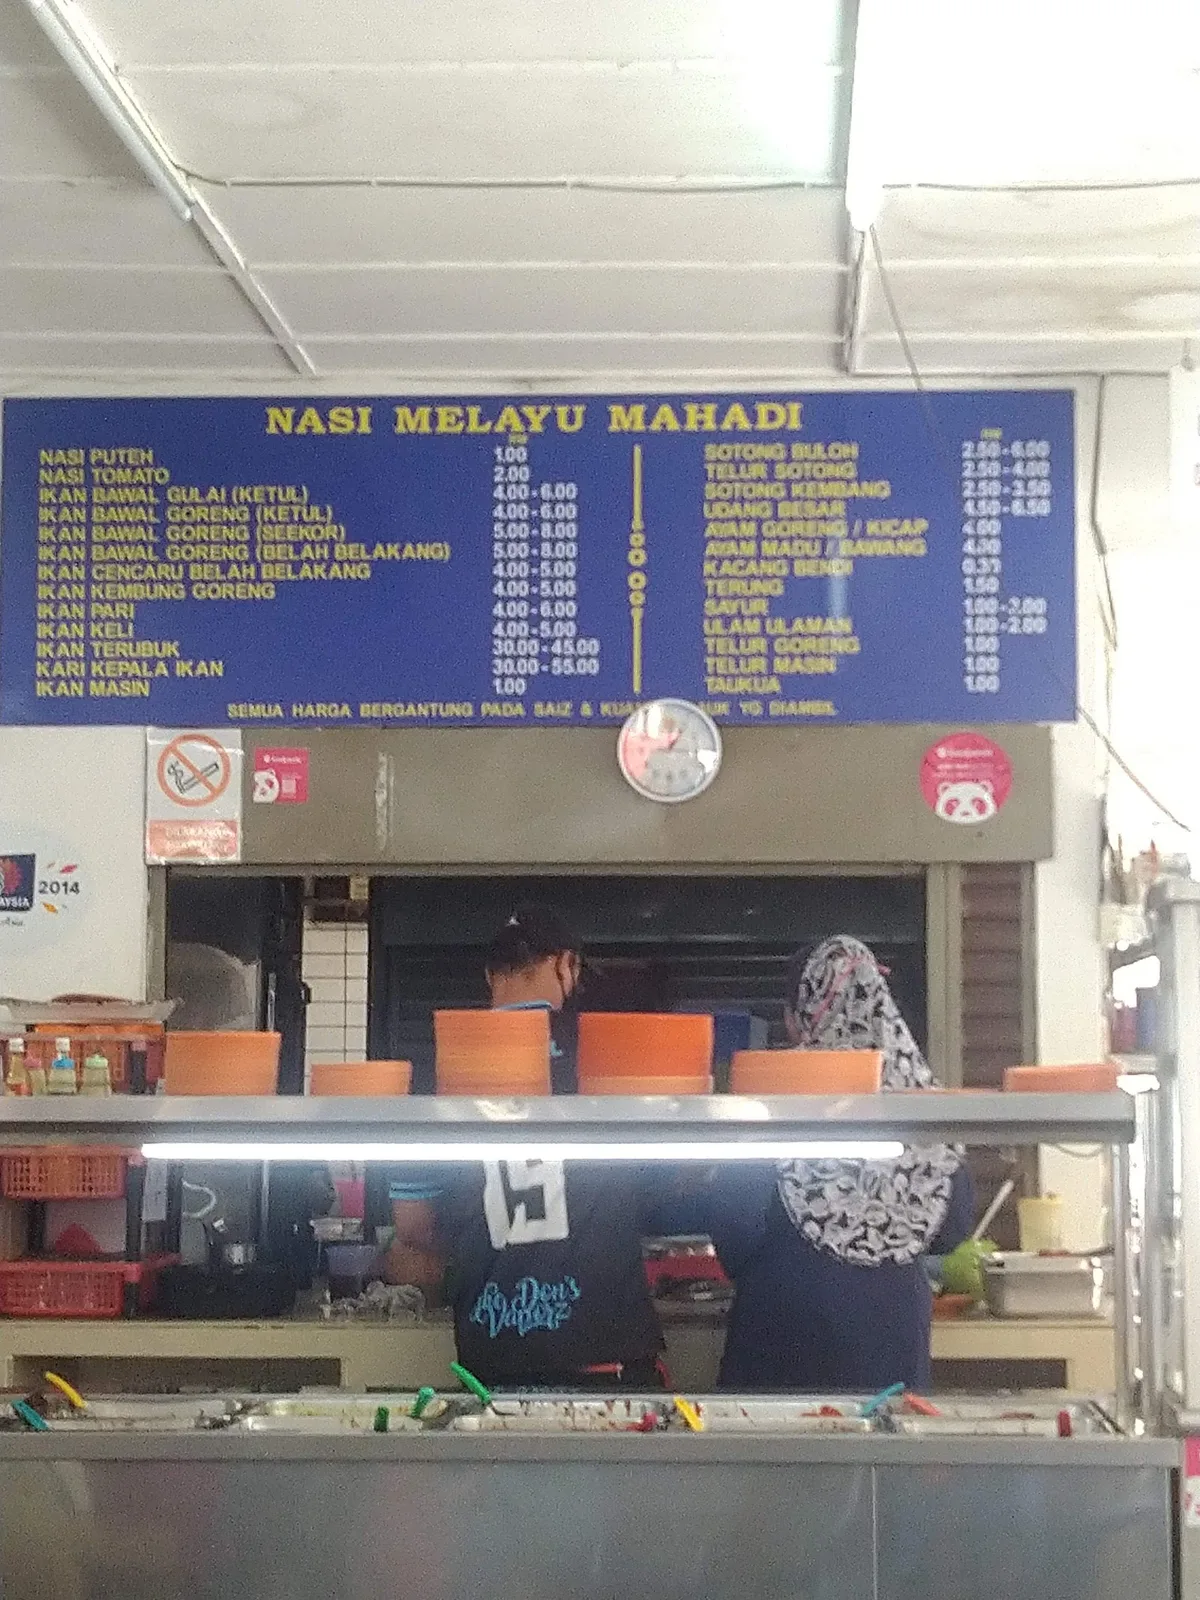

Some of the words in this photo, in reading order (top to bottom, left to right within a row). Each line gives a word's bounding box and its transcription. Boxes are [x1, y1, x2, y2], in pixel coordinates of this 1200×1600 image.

[266, 406, 372, 435] NASI
[395, 405, 585, 435] MELAYU
[608, 402, 803, 433] MAHADI
[40, 449, 84, 466] NASI
[90, 448, 153, 465] PUTEH
[494, 445, 527, 463] 1.00
[40, 468, 84, 485] NASI
[92, 467, 169, 484] TOMATO
[494, 465, 530, 482] 2.00
[40, 488, 86, 503] IKAN
[93, 487, 159, 504] BAWAL
[167, 486, 226, 503] GULAI
[232, 486, 308, 505] (KETUL)
[40, 507, 86, 522] IKAN
[92, 506, 159, 523] BAWAL
[166, 506, 250, 522] GORENG
[256, 505, 332, 524] (KETUL)
[39, 526, 85, 542] IKAN
[92, 525, 158, 542] BAWAL
[166, 525, 250, 541] GORENG
[256, 524, 345, 543] (SEEKOR)
[38, 545, 85, 561] IKAN
[92, 545, 159, 561] BAWAL
[166, 544, 249, 561] GORENG
[256, 544, 329, 563] (BELAH
[334, 544, 450, 563] BELAKANG)
[38, 564, 85, 581] IKAN
[92, 563, 183, 580] CENCARU
[190, 563, 255, 580] BELAH
[261, 563, 371, 580] BELAKANG
[38, 584, 85, 600] IKAN
[91, 583, 186, 600] KEMBUNG
[192, 582, 275, 600] GORENG
[38, 603, 85, 619] IKAN
[91, 603, 134, 619] PARI
[37, 622, 84, 638] IKAN
[91, 622, 133, 639] KELI
[37, 642, 84, 658] IKAN
[91, 640, 180, 658] TERUBUK
[704, 637, 767, 655] TELUR
[37, 661, 85, 677] KARI
[91, 661, 168, 677] KEPALA
[175, 660, 223, 677] IKAN
[704, 656, 767, 674] TELUR
[37, 680, 83, 697] IKAN
[90, 680, 149, 697] MASIN
[493, 678, 526, 695] 1.00
[228, 703, 283, 718] SEMUA
[292, 703, 351, 717] HARGA
[481, 702, 525, 717] PADA
[38, 880, 80, 895] 2014
